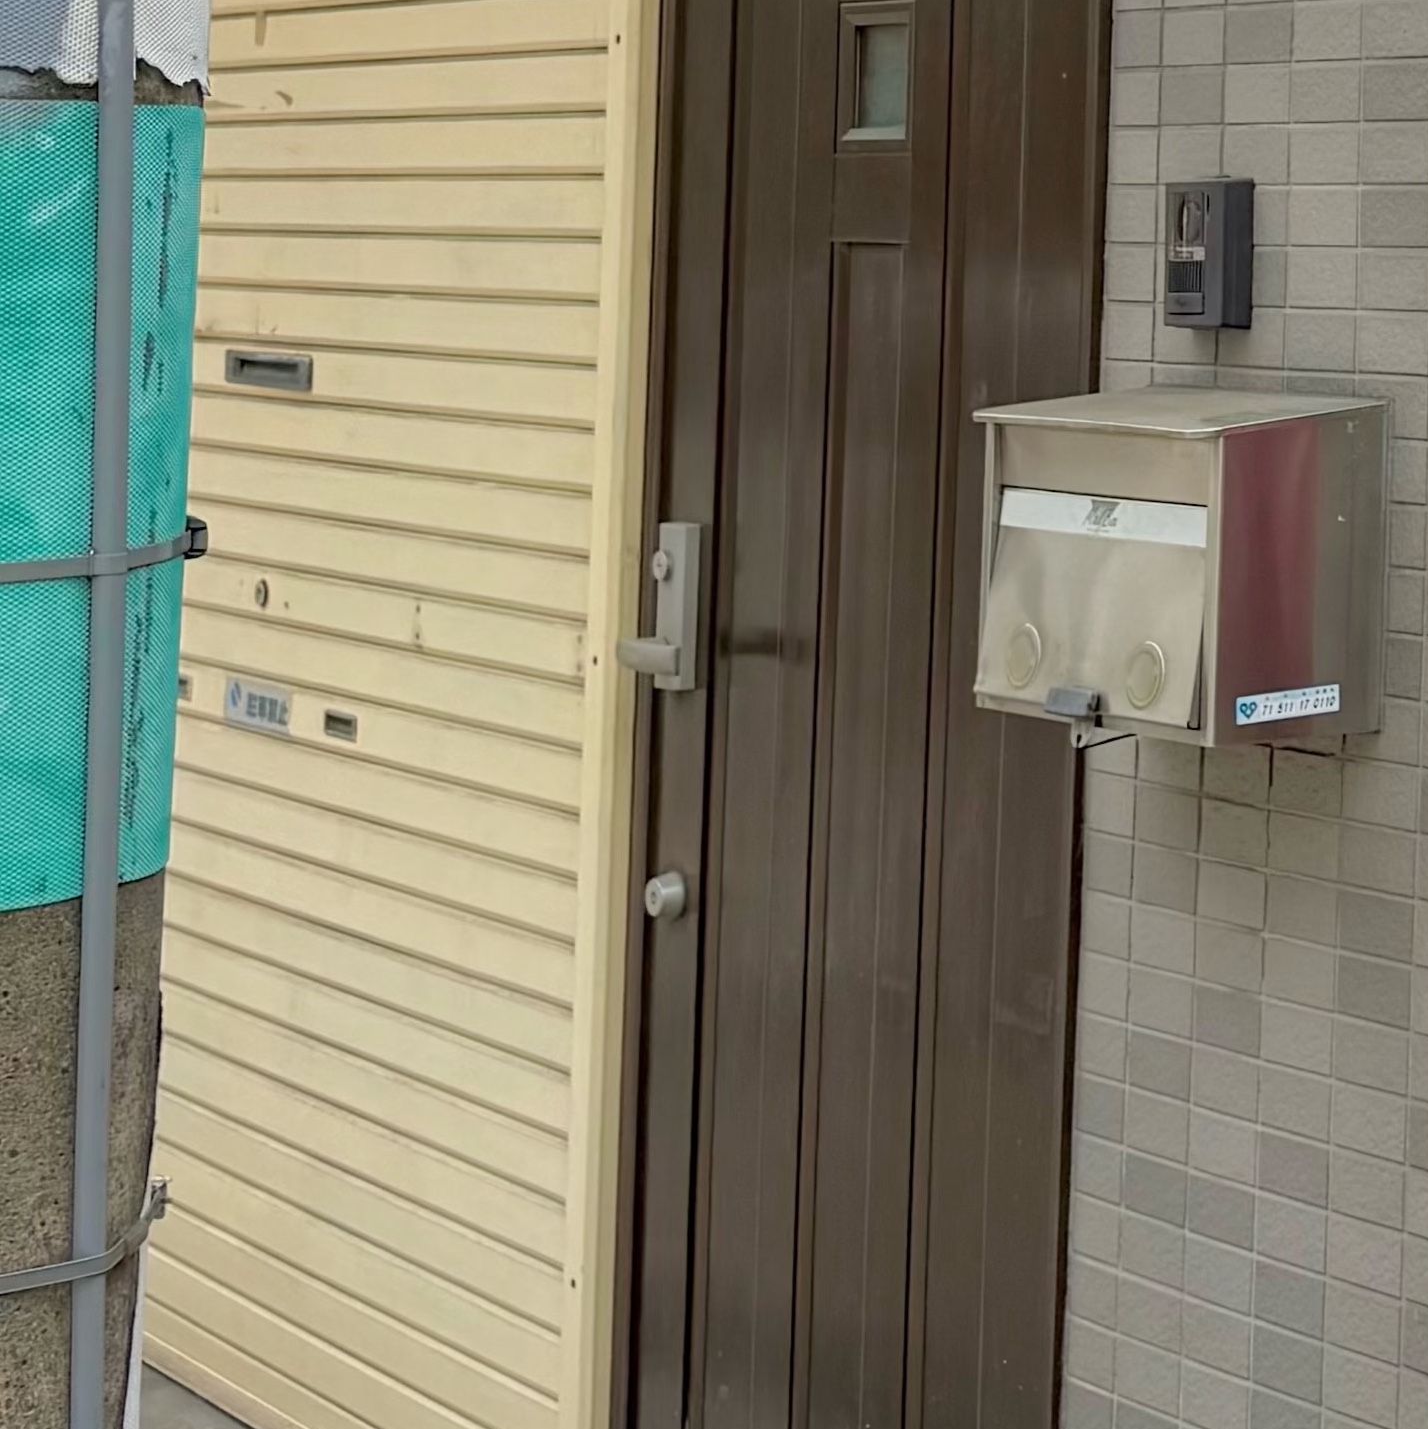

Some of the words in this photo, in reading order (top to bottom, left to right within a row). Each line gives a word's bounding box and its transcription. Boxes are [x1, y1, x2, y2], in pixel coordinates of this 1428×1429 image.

[1262, 704, 1273, 716] 71
[1299, 698, 1311, 710] 17
[1313, 695, 1336, 709] 0110
